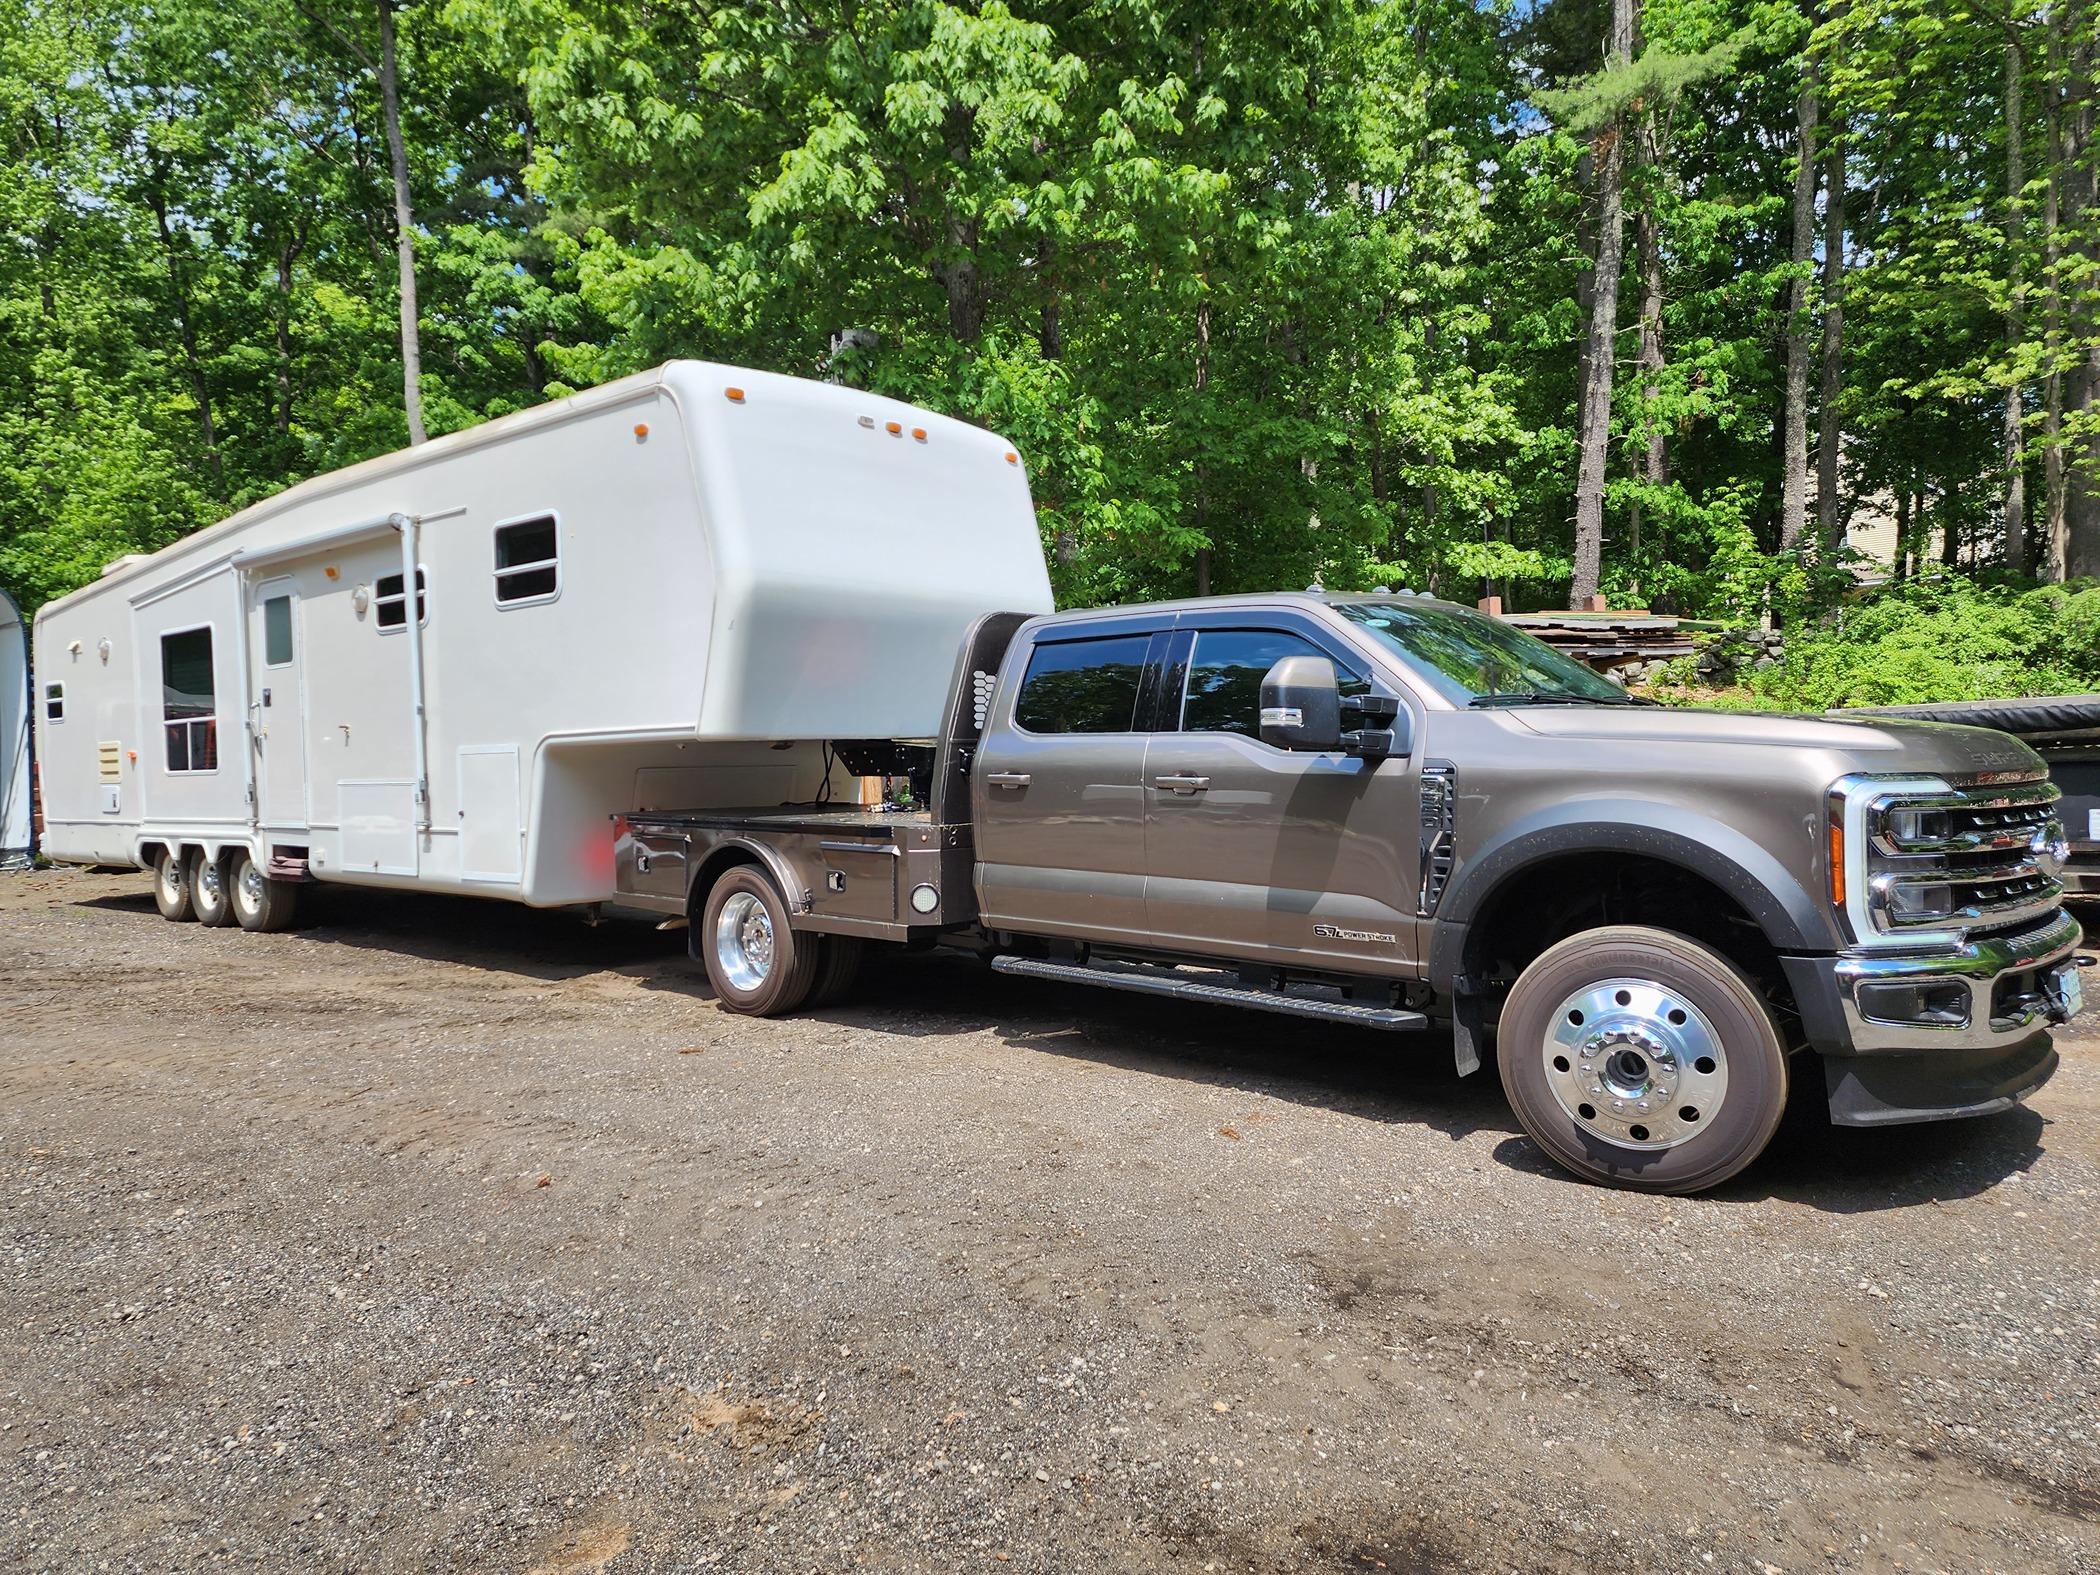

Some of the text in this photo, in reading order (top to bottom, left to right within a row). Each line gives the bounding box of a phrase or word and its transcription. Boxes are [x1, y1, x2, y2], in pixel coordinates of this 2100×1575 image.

[1313, 925, 1393, 941] 6.7L POWER STROKE
